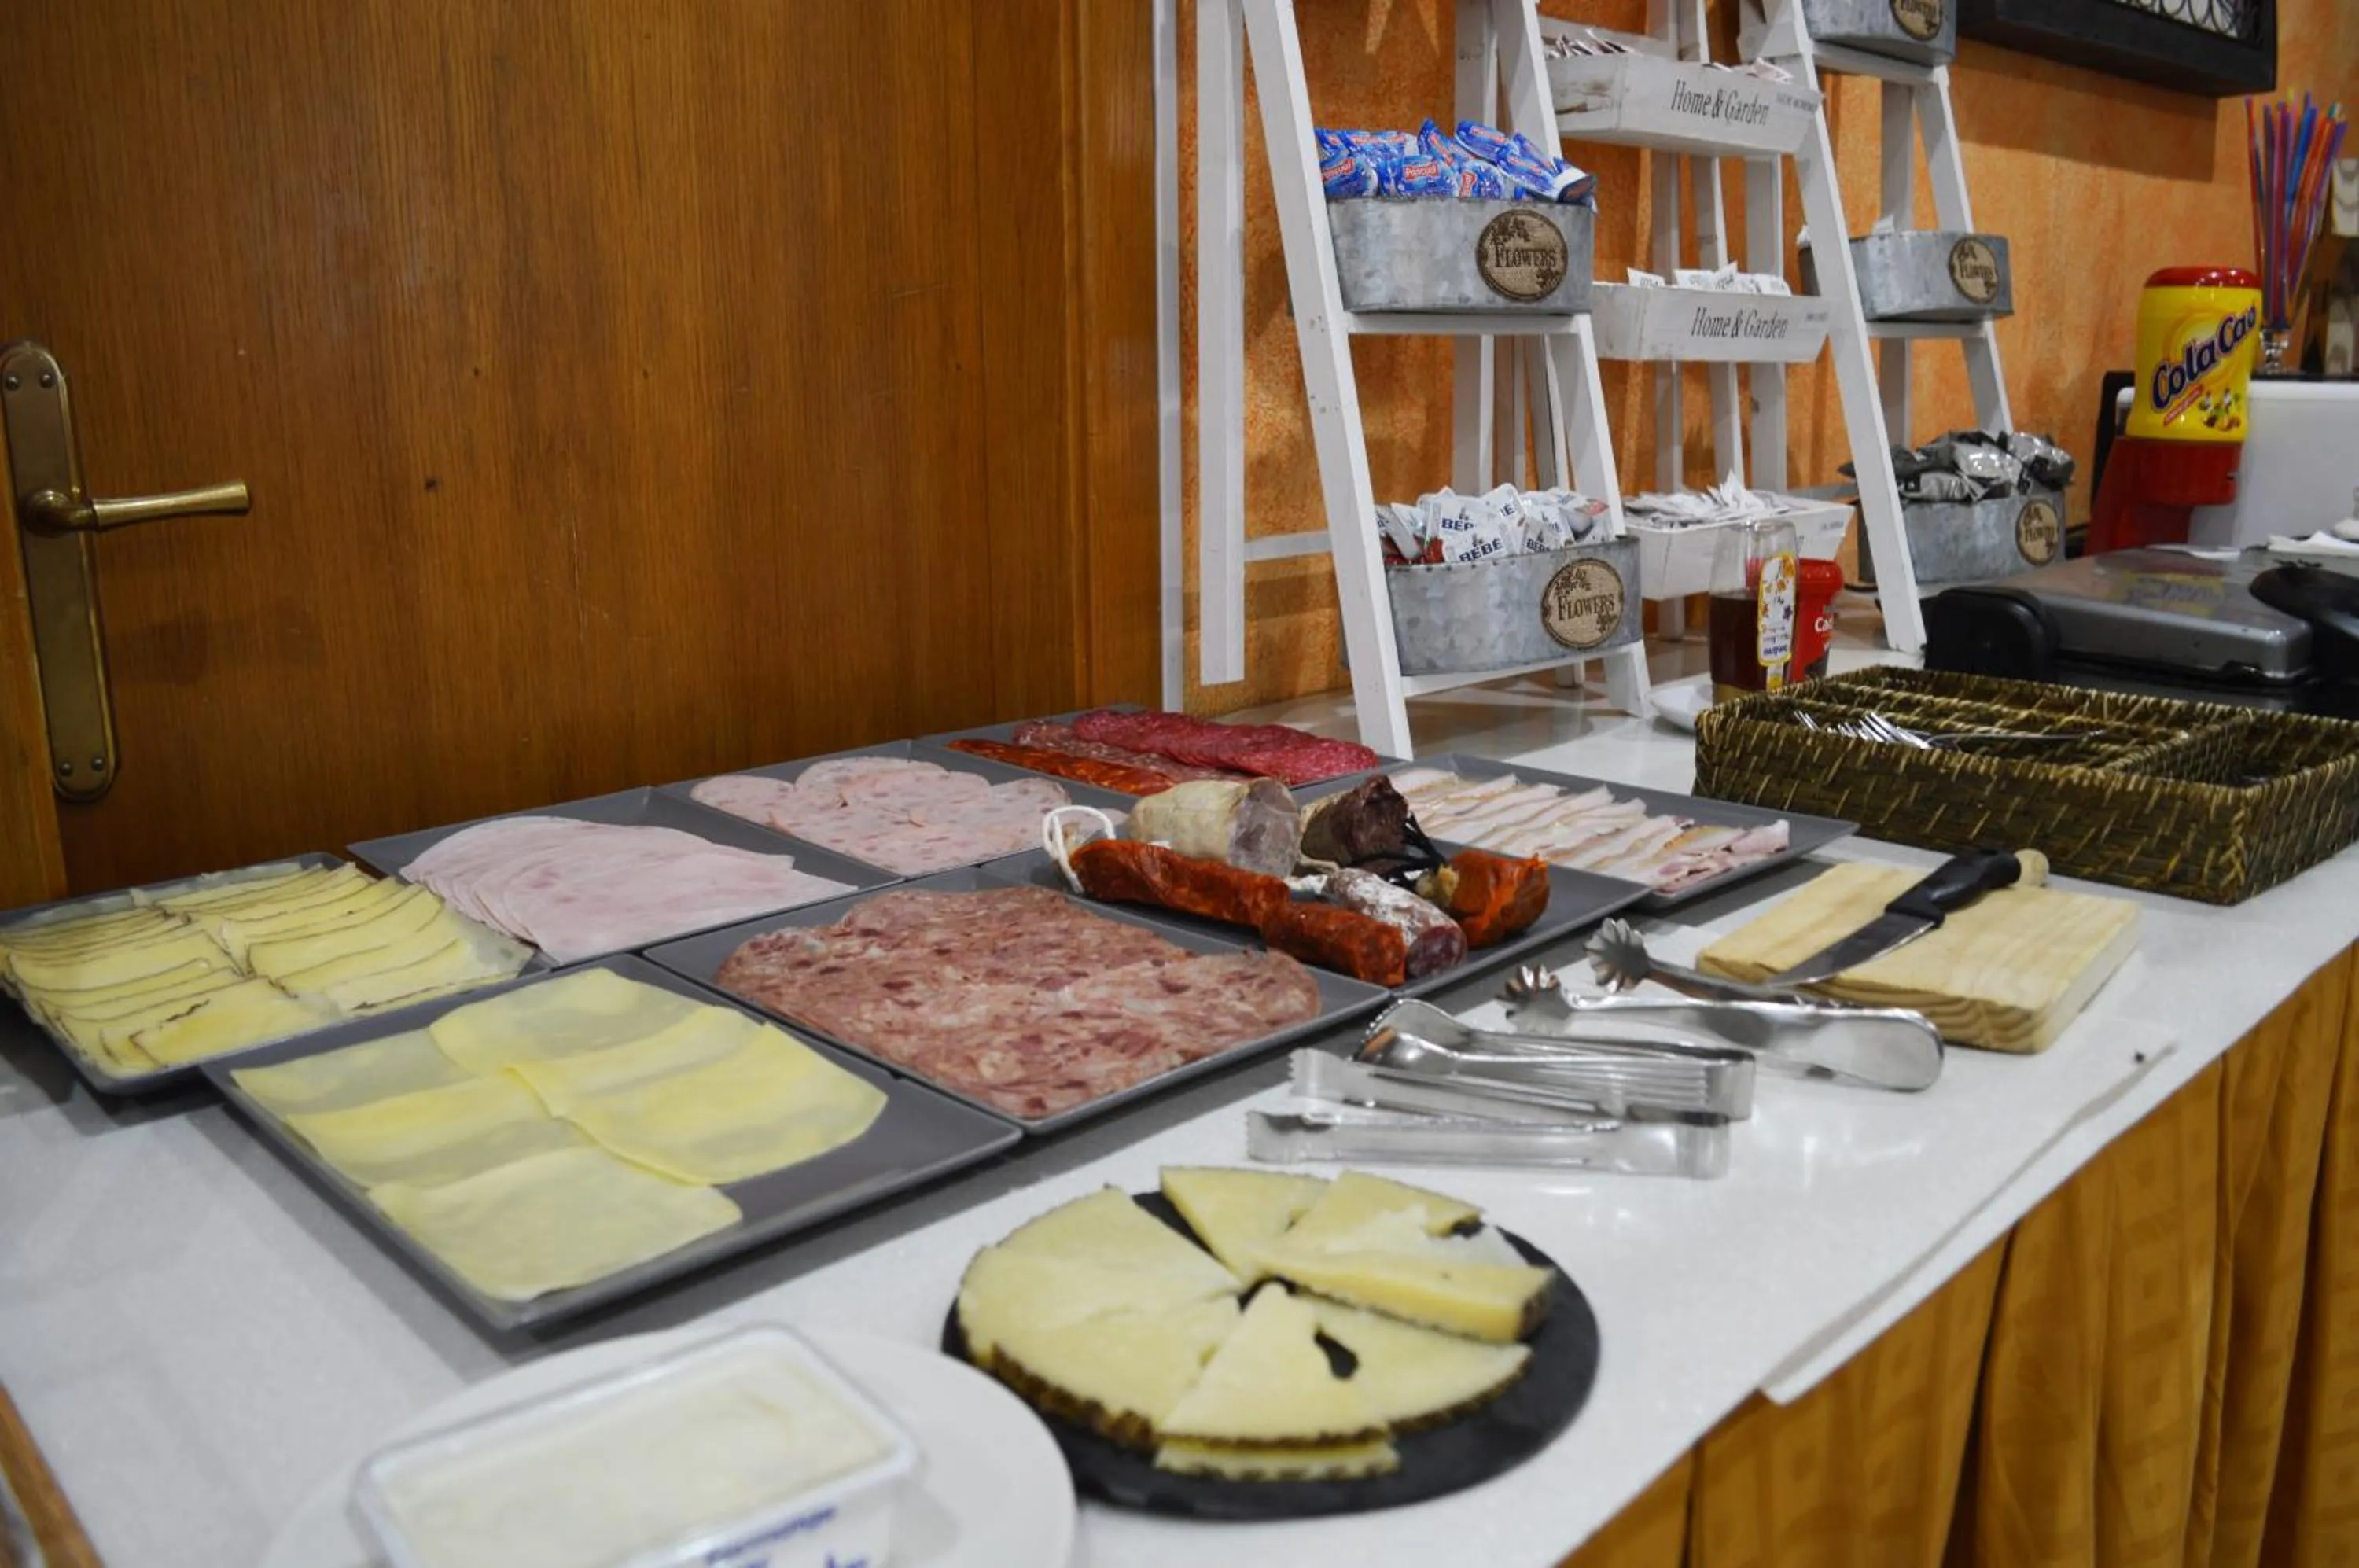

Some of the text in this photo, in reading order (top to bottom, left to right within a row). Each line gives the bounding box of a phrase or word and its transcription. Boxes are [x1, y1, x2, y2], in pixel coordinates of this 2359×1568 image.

[1671, 79, 1712, 117] Home
[1712, 88, 1724, 119] &
[1724, 90, 1770, 127] Garden
[1495, 242, 1556, 268] FLOWERS
[1691, 307, 1789, 339] Home & Garden
[1558, 594, 1614, 621] FLOWERS
